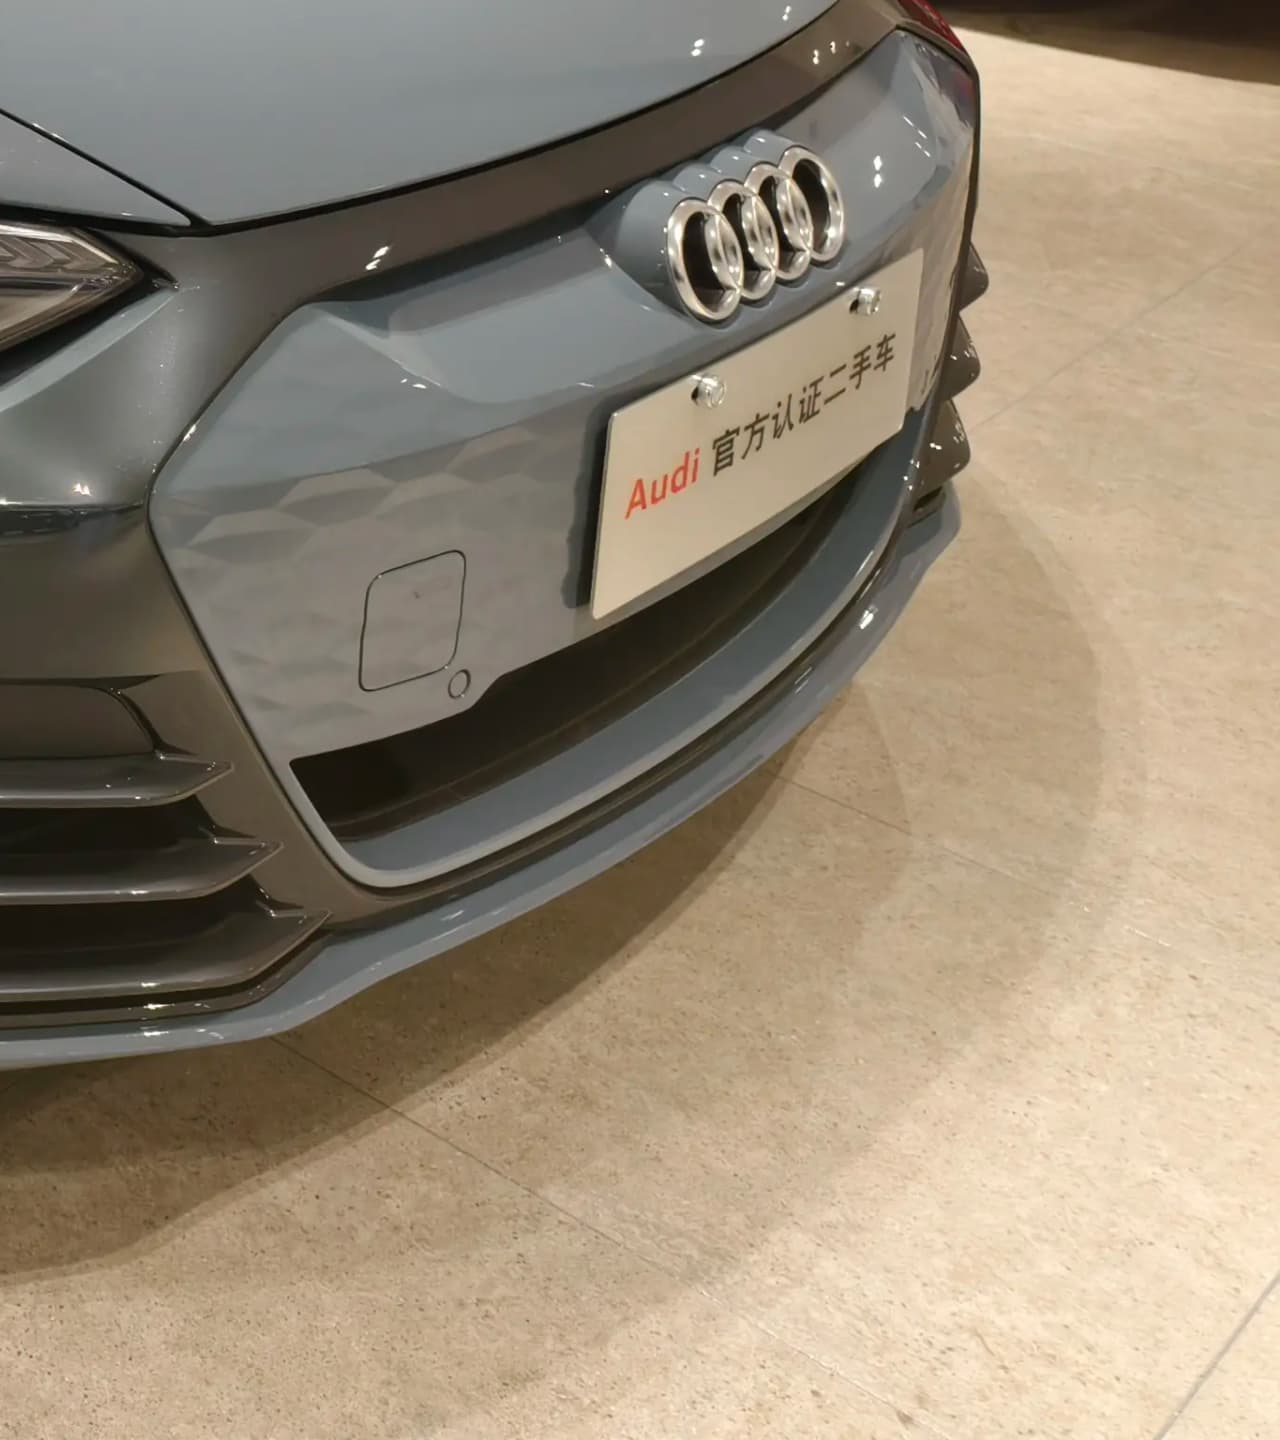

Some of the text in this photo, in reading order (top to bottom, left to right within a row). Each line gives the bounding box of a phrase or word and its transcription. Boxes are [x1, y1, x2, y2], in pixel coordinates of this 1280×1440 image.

[625, 332, 897, 520] Audi 官方认证二手车
